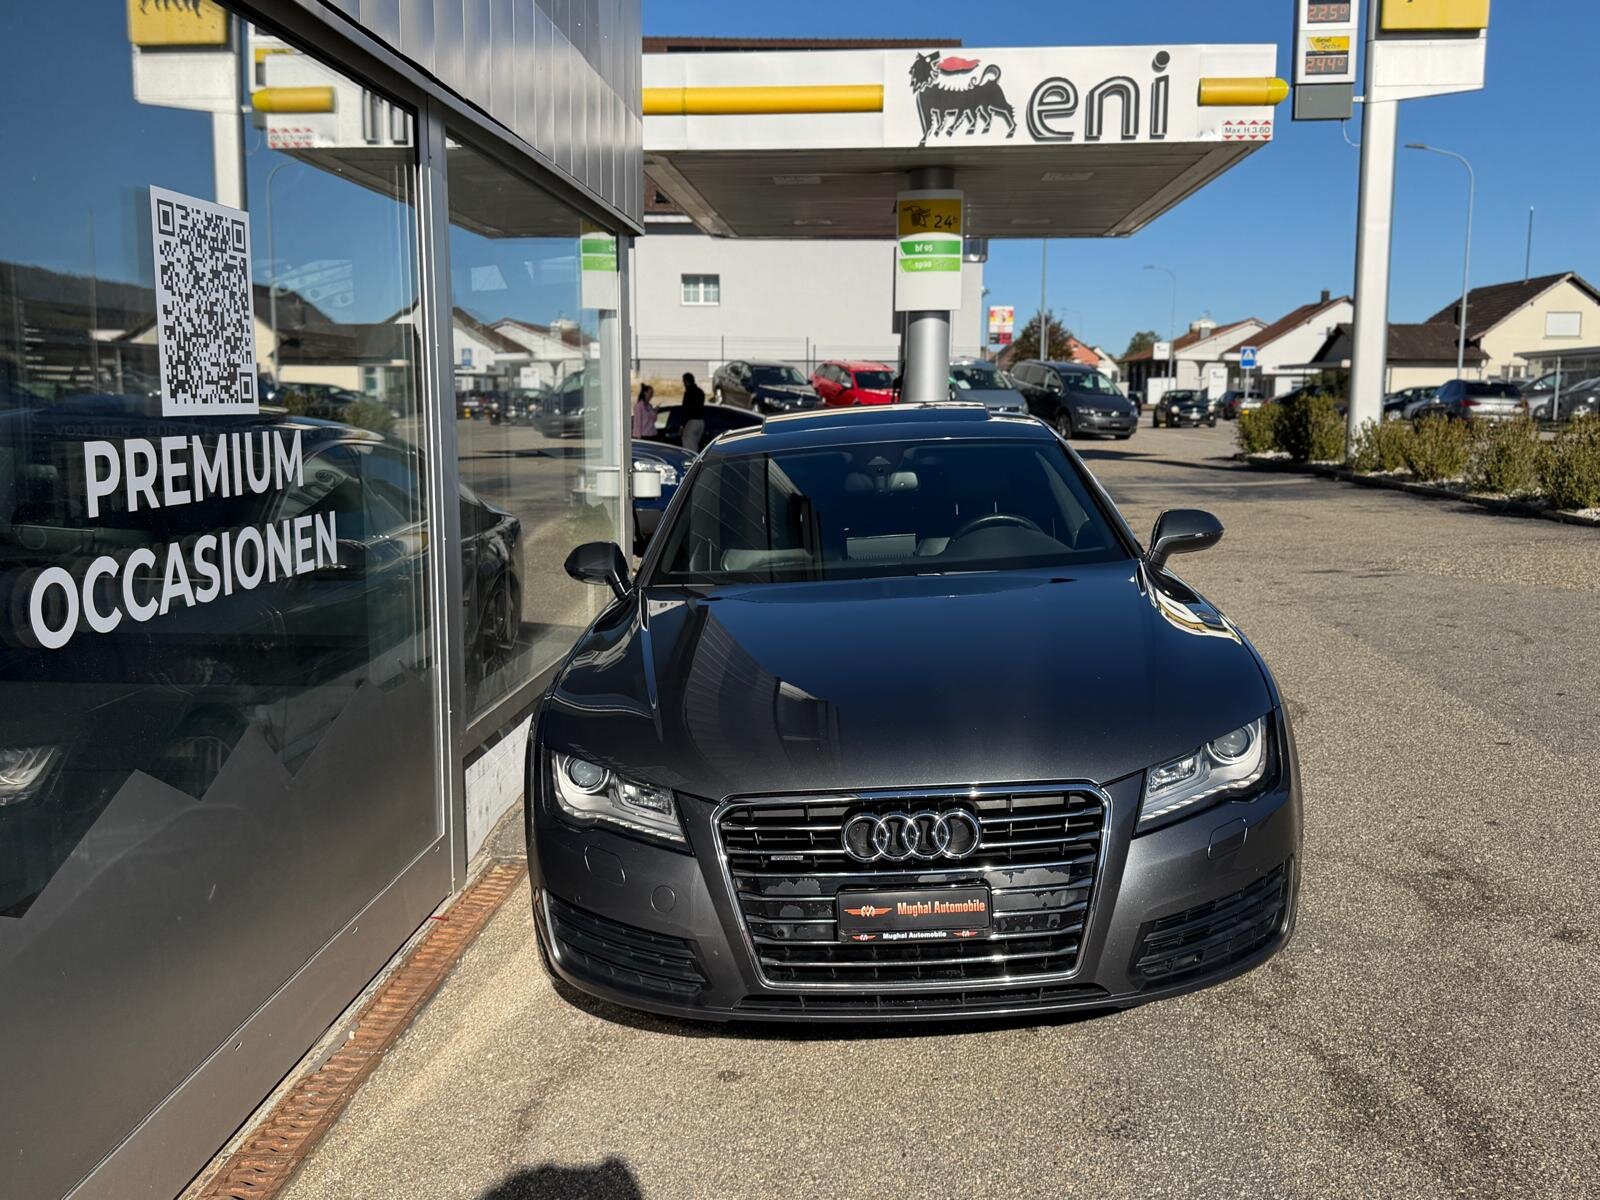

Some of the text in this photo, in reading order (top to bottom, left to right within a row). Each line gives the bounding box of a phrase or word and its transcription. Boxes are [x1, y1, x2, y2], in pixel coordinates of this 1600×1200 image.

[1027, 50, 1171, 142] eni
[1224, 126, 1241, 134] Max
[1244, 126, 1250, 134] H
[83, 430, 304, 518] PREMIUM
[29, 511, 338, 650] OCCASIONEN
[897, 899, 986, 917] Mughal Automobile
[882, 931, 947, 940] Mughal Automobile
